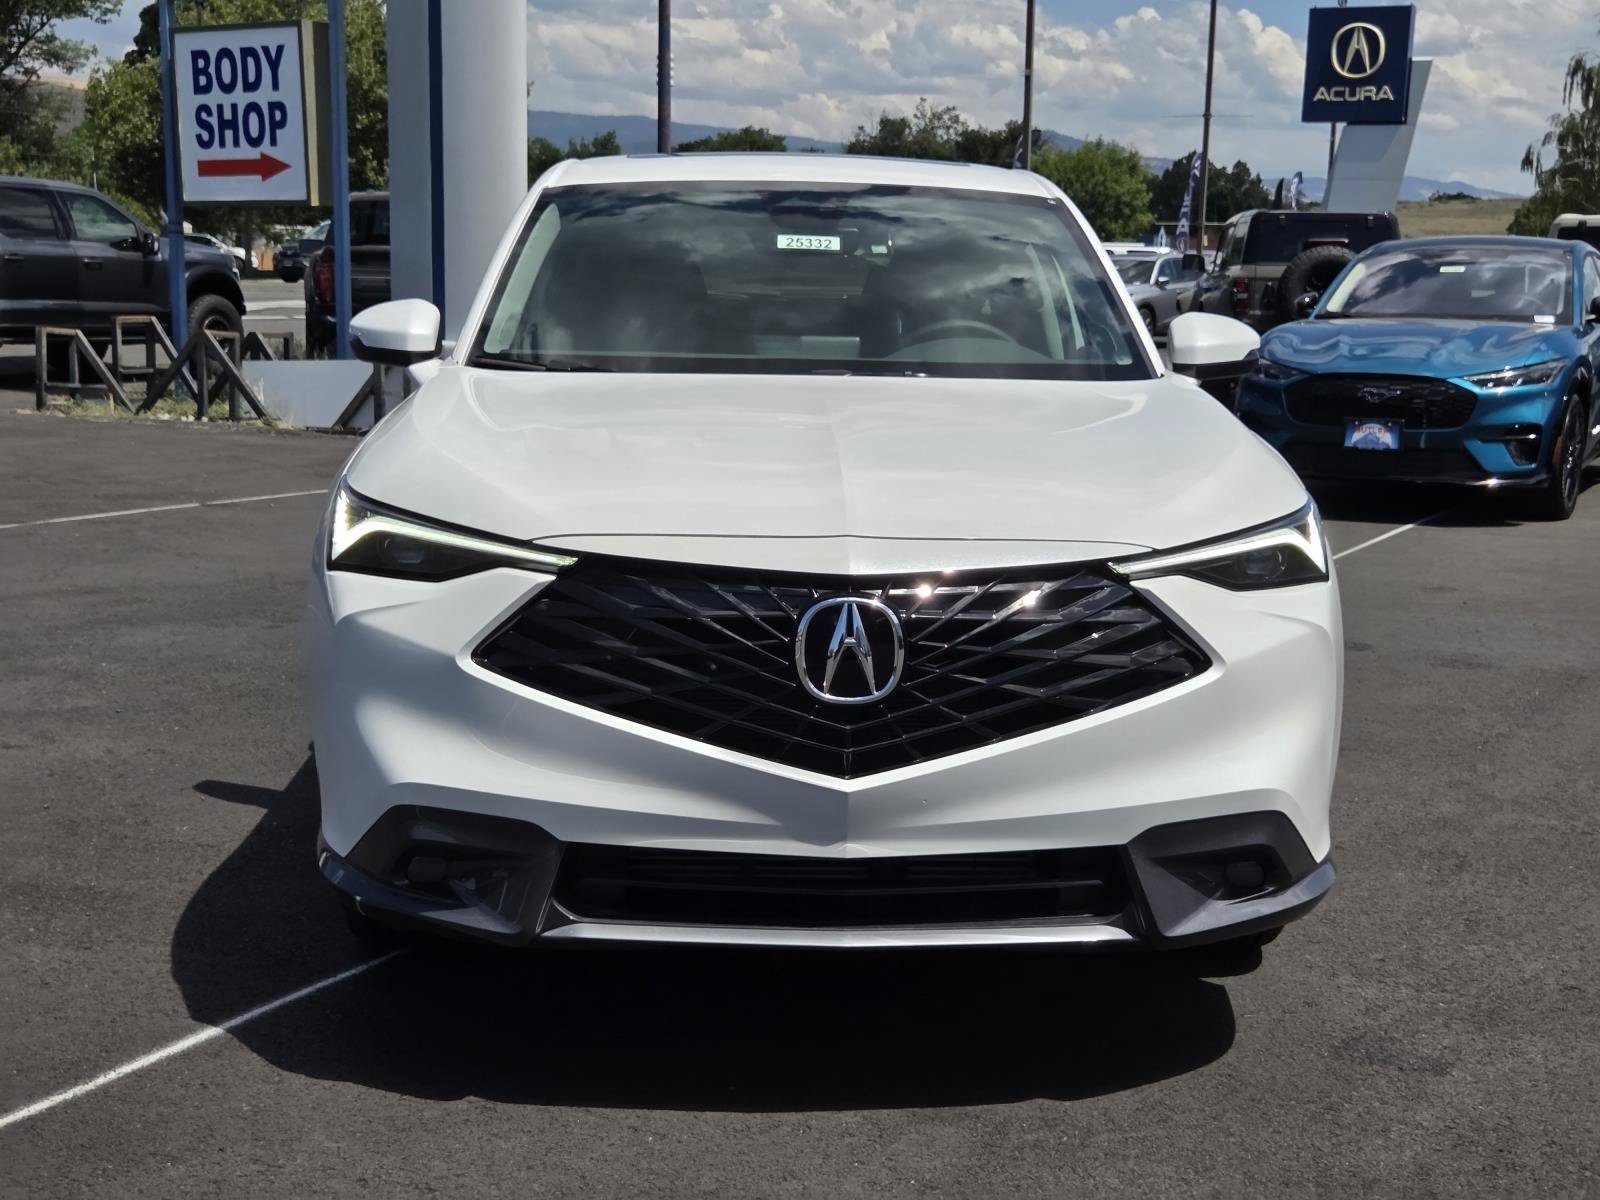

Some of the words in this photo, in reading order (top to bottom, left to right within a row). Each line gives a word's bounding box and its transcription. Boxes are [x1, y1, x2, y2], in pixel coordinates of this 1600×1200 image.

[190, 44, 285, 95] BODY
[1313, 85, 1394, 101] ACURA
[195, 101, 288, 149] SHOP
[785, 237, 832, 249] 25332
